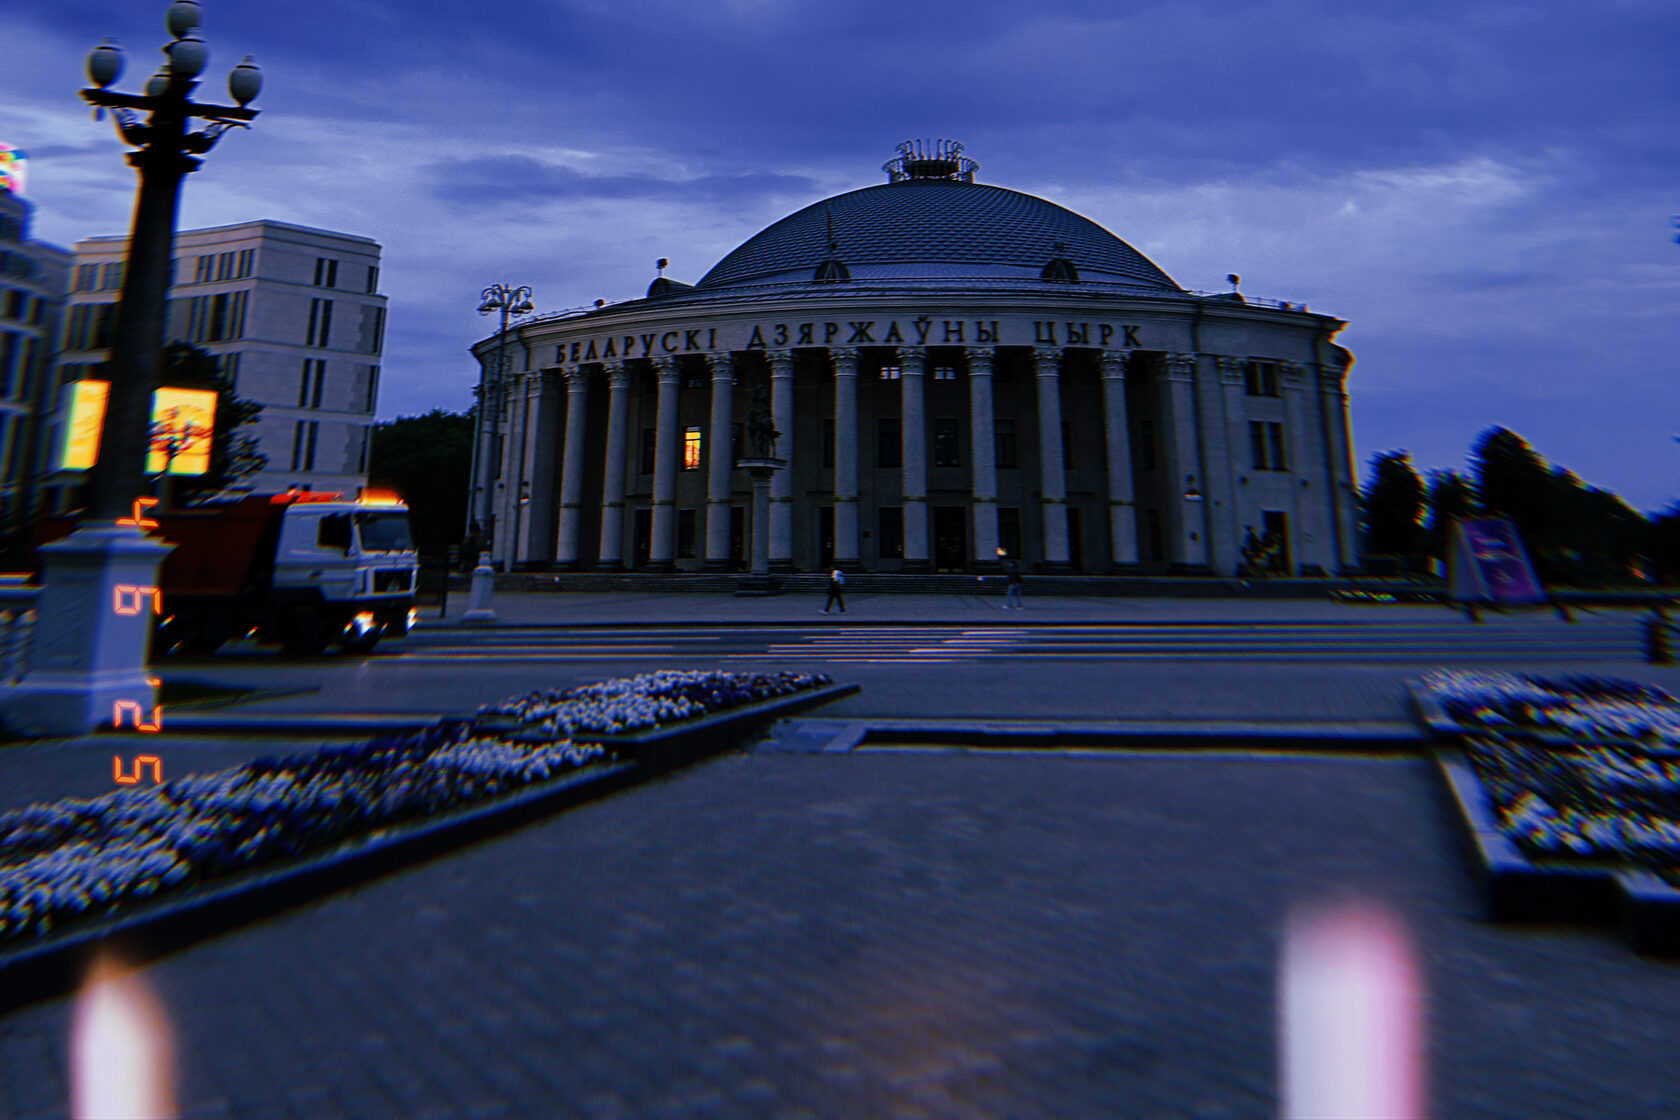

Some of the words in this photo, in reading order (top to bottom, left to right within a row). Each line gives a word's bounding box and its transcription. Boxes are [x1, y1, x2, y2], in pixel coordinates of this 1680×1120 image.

[555, 327, 718, 364] БЕЛАРУСКІ
[746, 315, 1001, 351] ДЗЯРЖАЎНЫ
[1033, 320, 1143, 348] ЦЫРК
